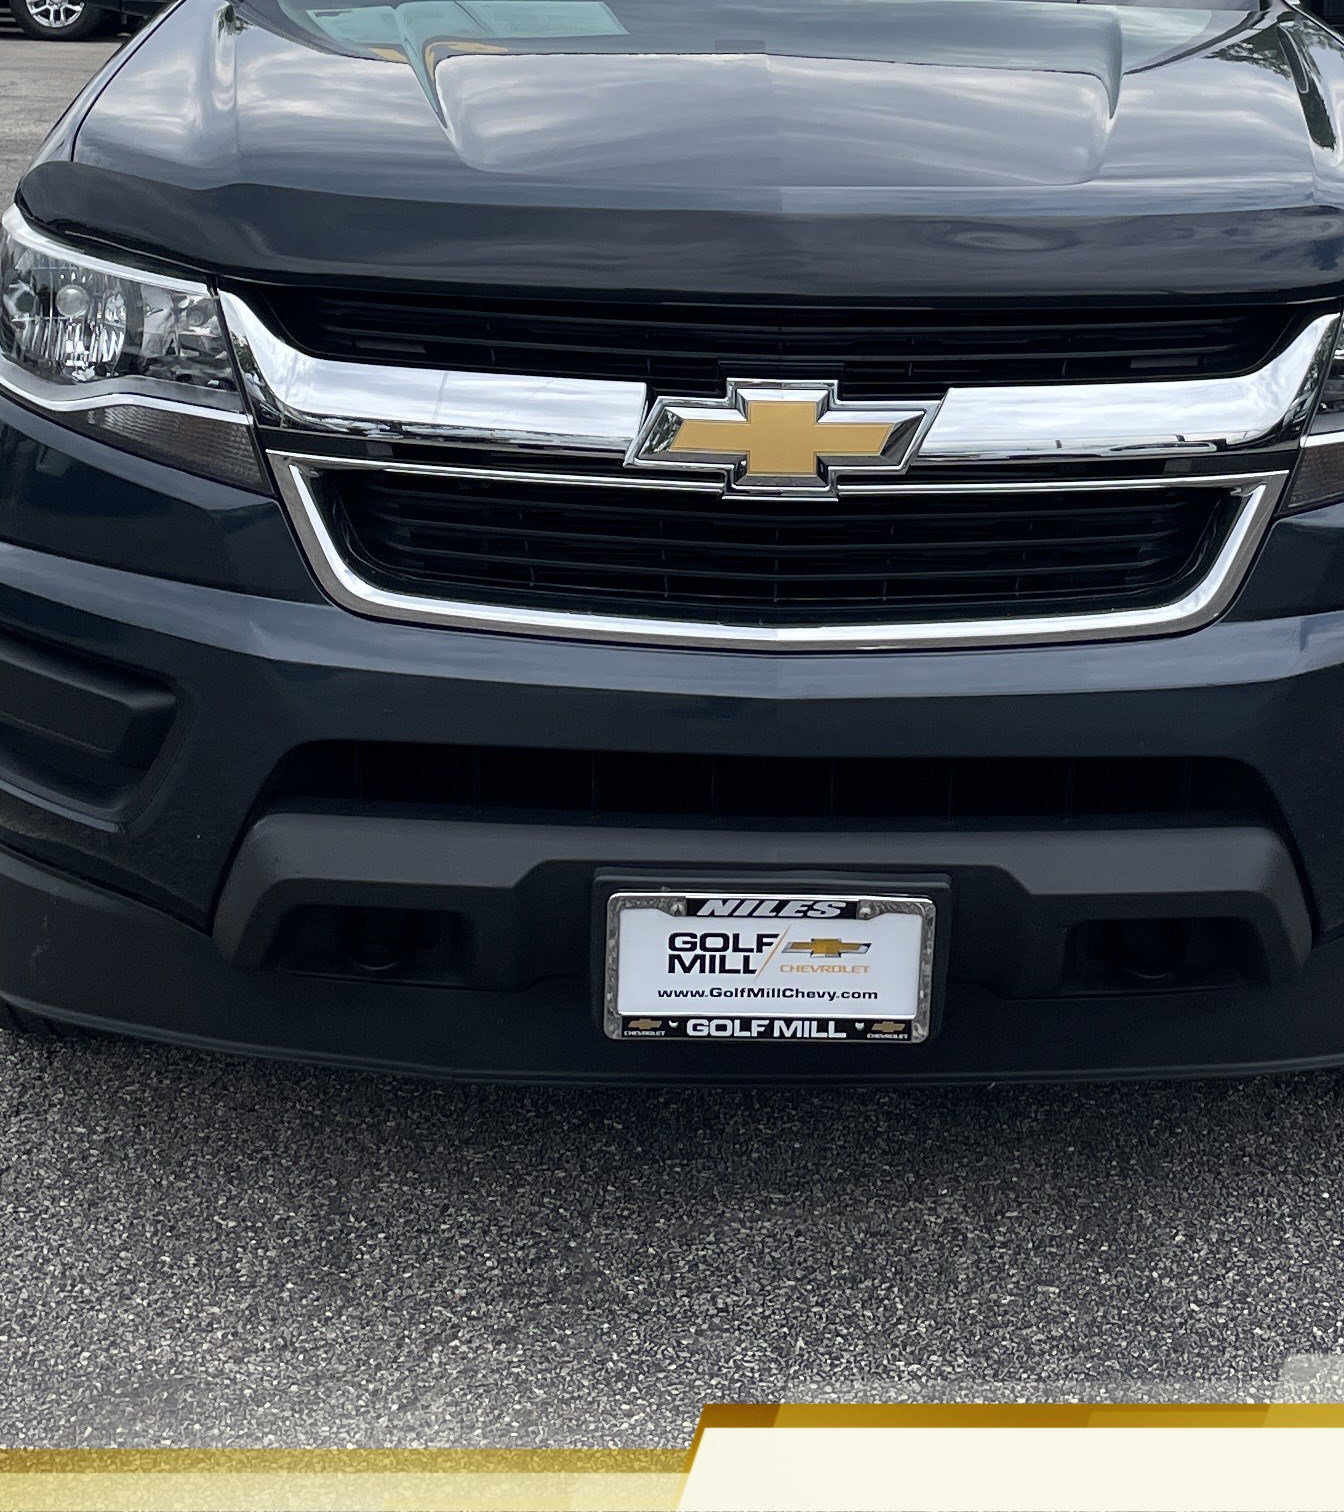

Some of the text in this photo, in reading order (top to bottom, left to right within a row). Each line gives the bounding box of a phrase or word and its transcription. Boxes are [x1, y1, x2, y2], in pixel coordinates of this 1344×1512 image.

[696, 898, 847, 919] NILES
[668, 931, 780, 954] GOLF
[668, 954, 758, 975] MILL
[779, 964, 871, 974] CHEVROLET
[657, 986, 879, 1001] www.GolfMillChevy.com
[687, 1019, 847, 1039] GOLF MILL
